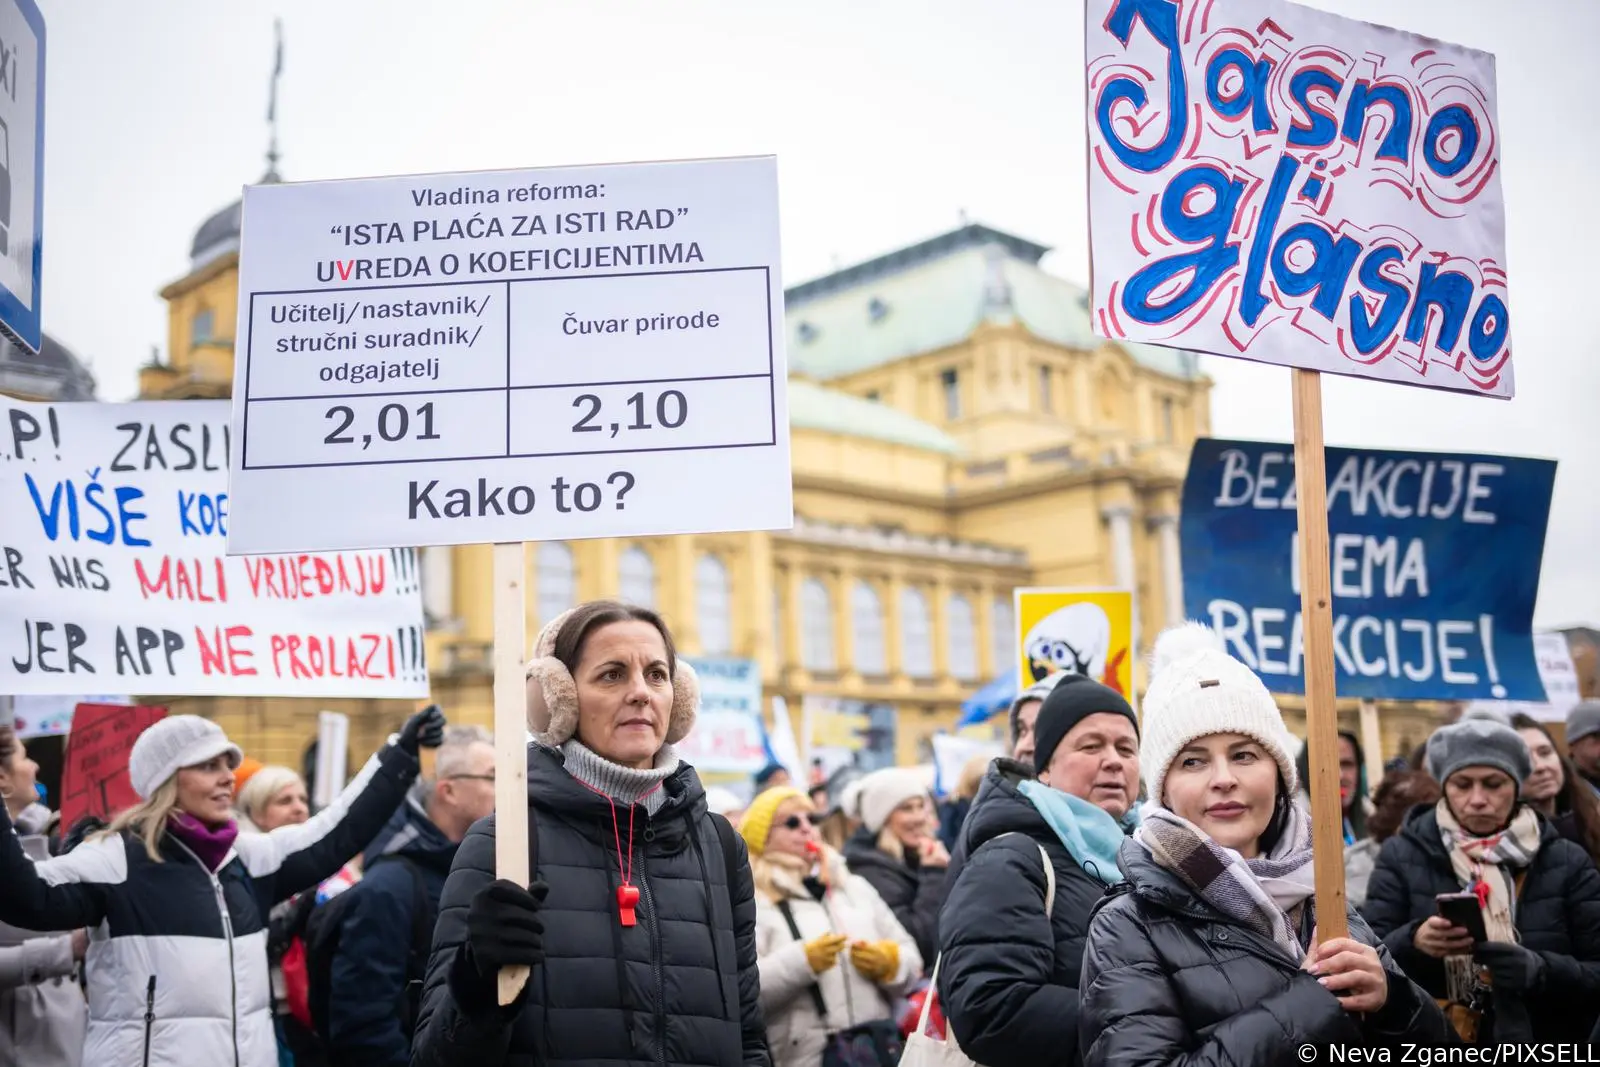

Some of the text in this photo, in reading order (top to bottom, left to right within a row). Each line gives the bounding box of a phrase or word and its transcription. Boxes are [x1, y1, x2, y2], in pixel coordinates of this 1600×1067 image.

[1095, 0, 1481, 178] Jasno
[412, 183, 604, 206] Vladina reforma:
[1298, 158, 1328, 207] i
[331, 208, 688, 245] “ISTA PLAĆA ZA ISTI RAD”
[317, 242, 704, 282] UVREDA O KOEFICIJENTIMA
[1121, 151, 1510, 363] glasno
[271, 295, 490, 324] Učitelj/nastavnik/
[563, 311, 719, 335] Čuvar prirode
[276, 325, 482, 352] stručni suradnik/
[320, 358, 439, 383] odgajatelj
[324, 402, 440, 450] 2,01
[571, 389, 688, 438] 2,10
[24, 467, 152, 547] VIŠE
[409, 471, 635, 519] Kako to?
[1327, 455, 1505, 524] AKCIJE
[48, 555, 111, 592] NAS
[134, 554, 228, 602] MALI
[12, 618, 97, 674] JER
[114, 625, 186, 677] APP
[194, 624, 259, 677] NE
